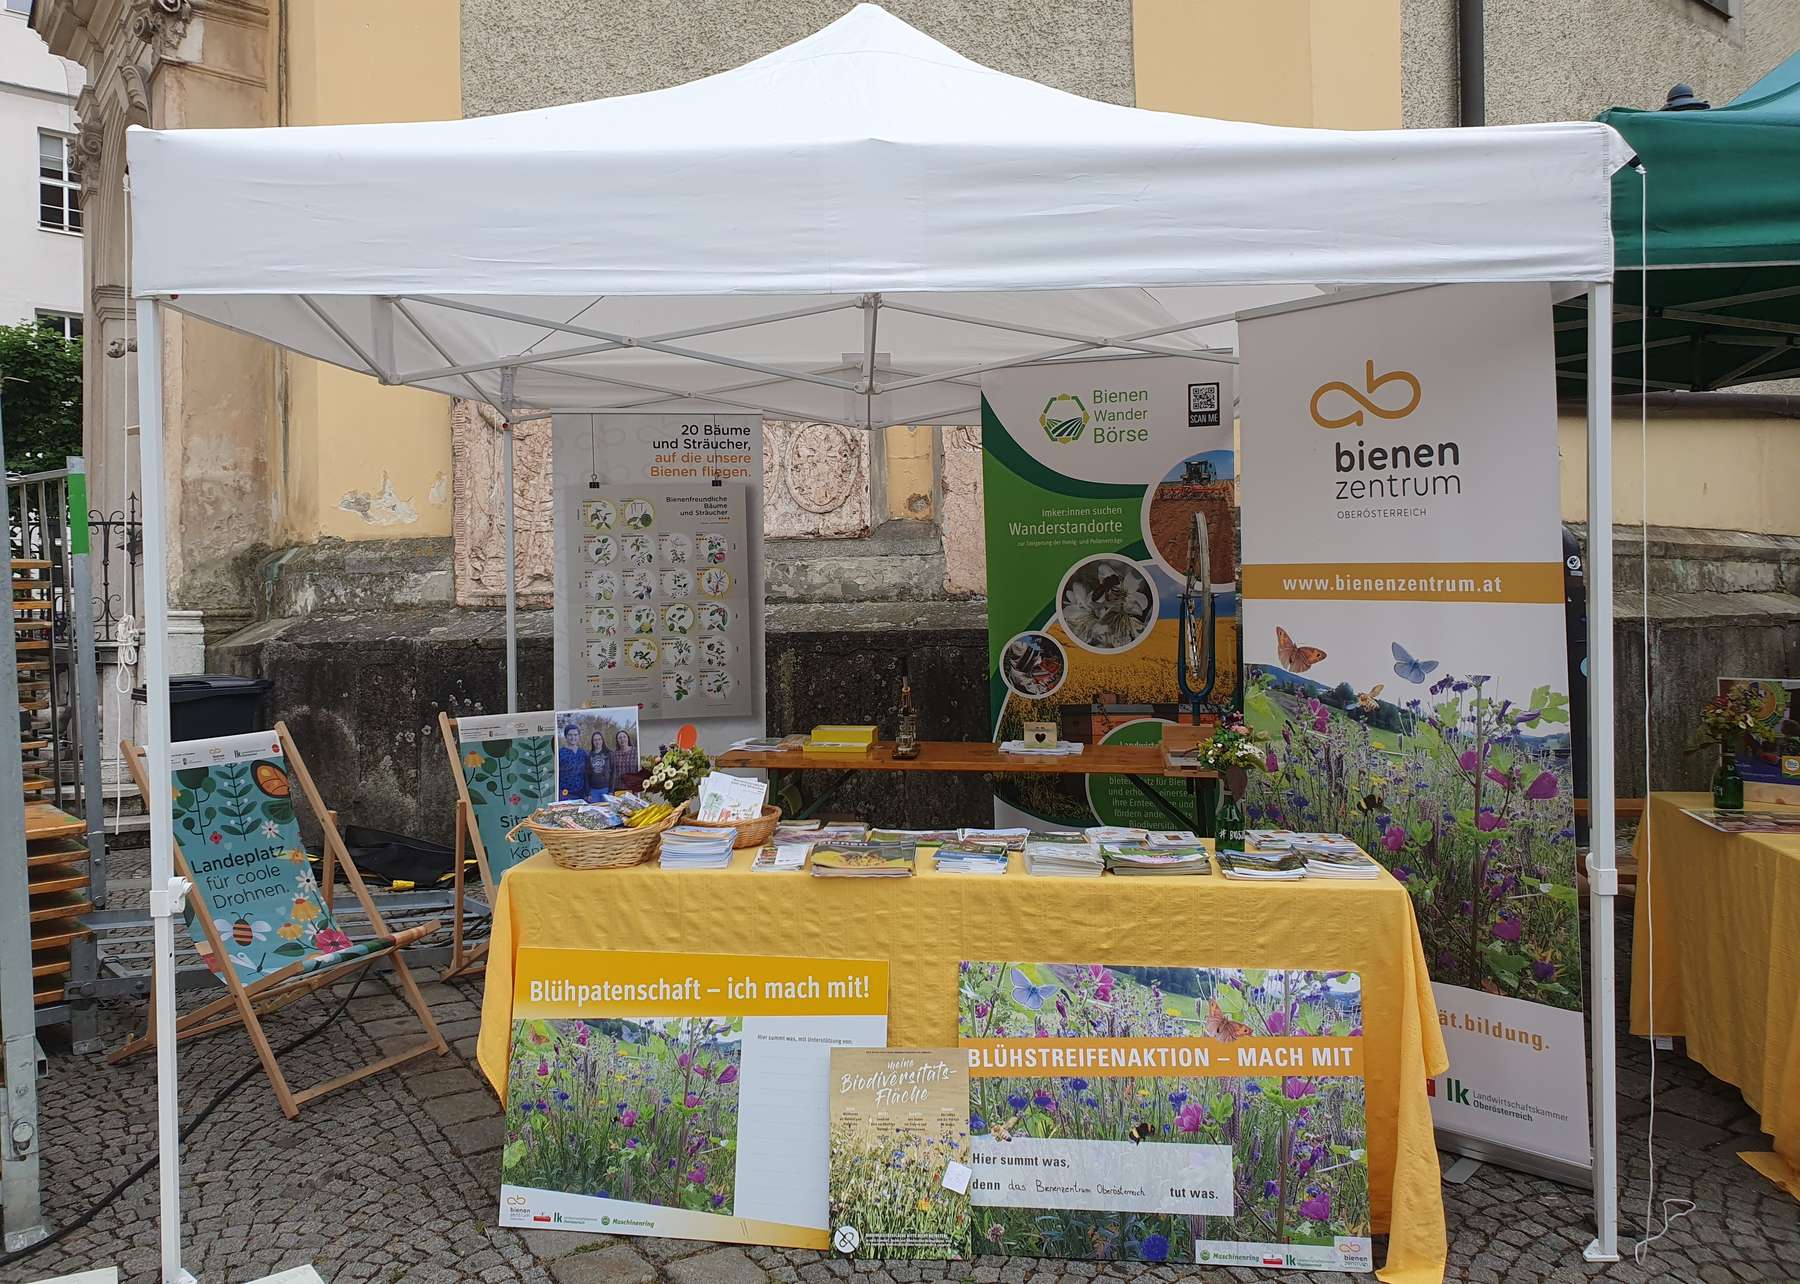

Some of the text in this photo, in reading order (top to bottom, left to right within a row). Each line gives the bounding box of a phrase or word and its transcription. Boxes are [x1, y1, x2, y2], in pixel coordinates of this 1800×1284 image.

[1093, 389, 1148, 404] Bienen
[1094, 408, 1148, 423] Wander
[1190, 413, 1219, 424] SCAN ME
[681, 424, 751, 436] 20 Bäume
[1094, 426, 1149, 444] Börse
[653, 438, 751, 451] und Sträucher,
[655, 452, 752, 463] auf die unsere
[1335, 440, 1460, 473] bienen
[650, 466, 752, 478] Bienen fliegen.
[1335, 474, 1461, 500] zentrum
[1042, 506, 1122, 517] Imker:innen suchen
[1336, 507, 1427, 520] OBERÖSTERREICH
[1009, 519, 1123, 536] Wanderstandorte
[1282, 574, 1502, 593] www.bienenzentrum.at
[191, 843, 285, 875] Landeplatz
[206, 864, 281, 892] für coole
[213, 883, 290, 910] Drohnen.
[529, 976, 701, 1007] Blühpatenschaft
[727, 975, 757, 999] ich
[765, 975, 820, 1000] mach
[828, 975, 870, 999] mit!
[887, 1057, 914, 1071] meine
[968, 1044, 1210, 1067] BLÜHSTREIFENAKTION
[1238, 1047, 1303, 1066] MACH
[1312, 1047, 1353, 1066] MIT
[840, 1061, 957, 1094] Biodiversitäts-
[875, 1085, 928, 1106] Fläche
[1447, 1077, 1470, 1105] lk
[1473, 1090, 1569, 1122] Landwirtschaftskammer
[1473, 1100, 1533, 1122] Oberösterreich
[972, 1152, 1070, 1169] Hier summt was,
[972, 1178, 1001, 1191] denn
[1008, 1179, 1027, 1191] das
[1170, 1187, 1219, 1199] tut was.
[553, 1212, 563, 1223] lk
[612, 1218, 655, 1228] Maschinenring
[1213, 1252, 1260, 1263] Maschinenring
[1285, 1254, 1296, 1266] lk
